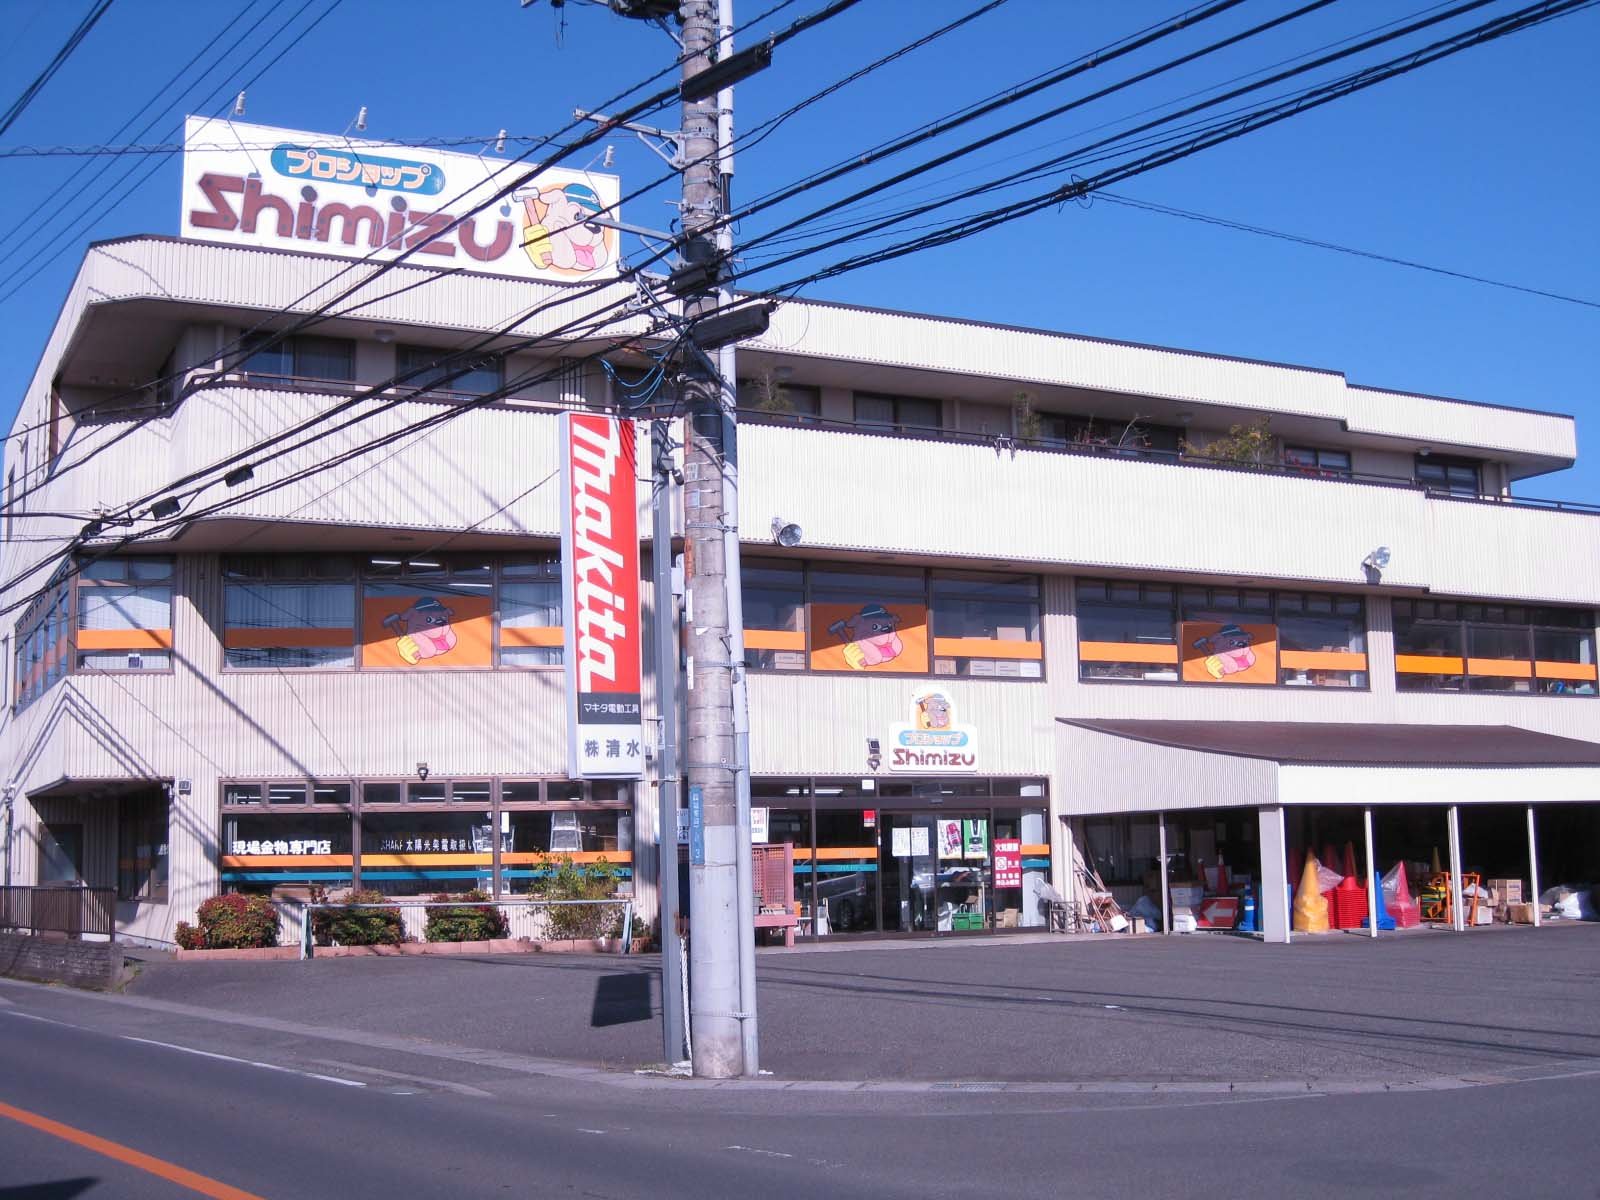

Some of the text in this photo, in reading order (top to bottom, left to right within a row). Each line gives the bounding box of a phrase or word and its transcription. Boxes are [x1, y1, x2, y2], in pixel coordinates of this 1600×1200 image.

[286, 150, 432, 190] プロショップ
[190, 171, 514, 263] Shimizu
[573, 418, 627, 693] makita
[583, 702, 639, 714] マキタ電動工具
[892, 748, 976, 766] Shimizu
[232, 839, 332, 855] 現場金物専門店
